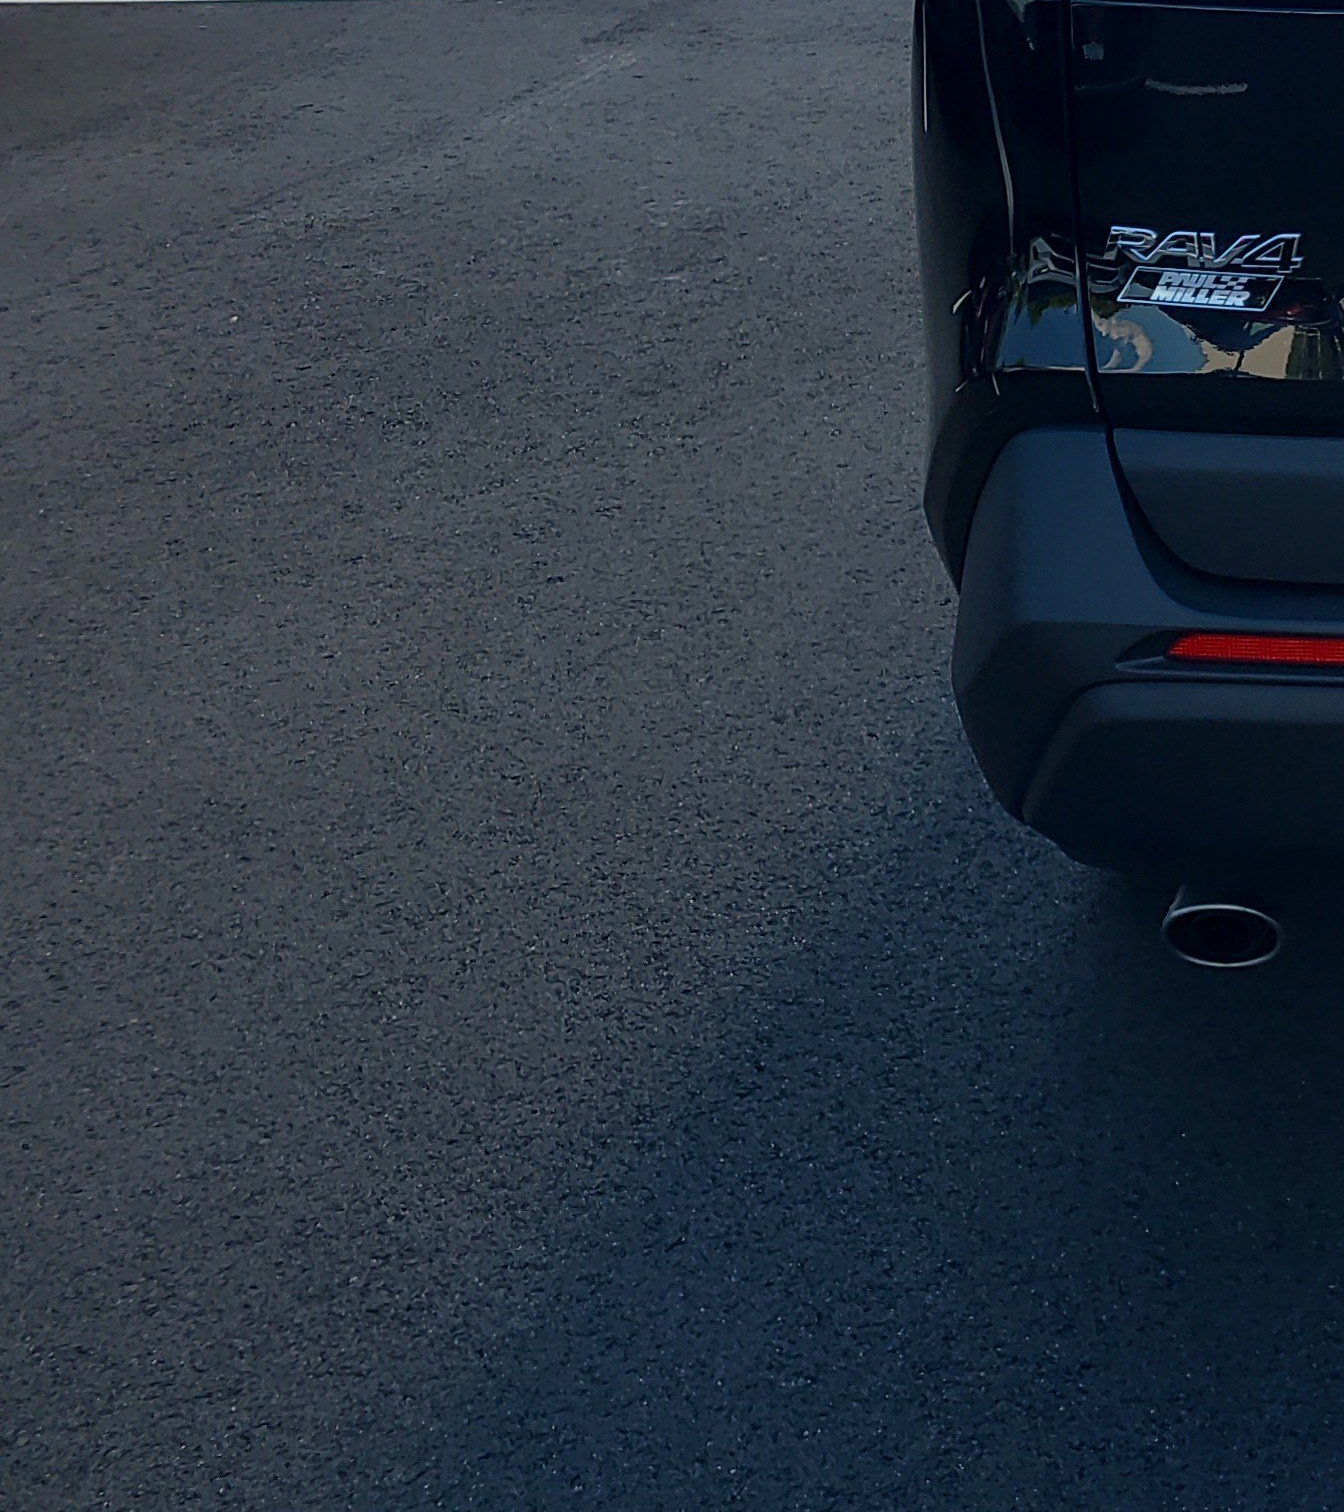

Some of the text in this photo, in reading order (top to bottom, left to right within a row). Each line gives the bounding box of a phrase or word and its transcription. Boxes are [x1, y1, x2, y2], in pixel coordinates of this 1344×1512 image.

[1103, 226, 1304, 273] RAV4
[1158, 272, 1218, 289] PAUL
[1150, 285, 1251, 307] MILLER
